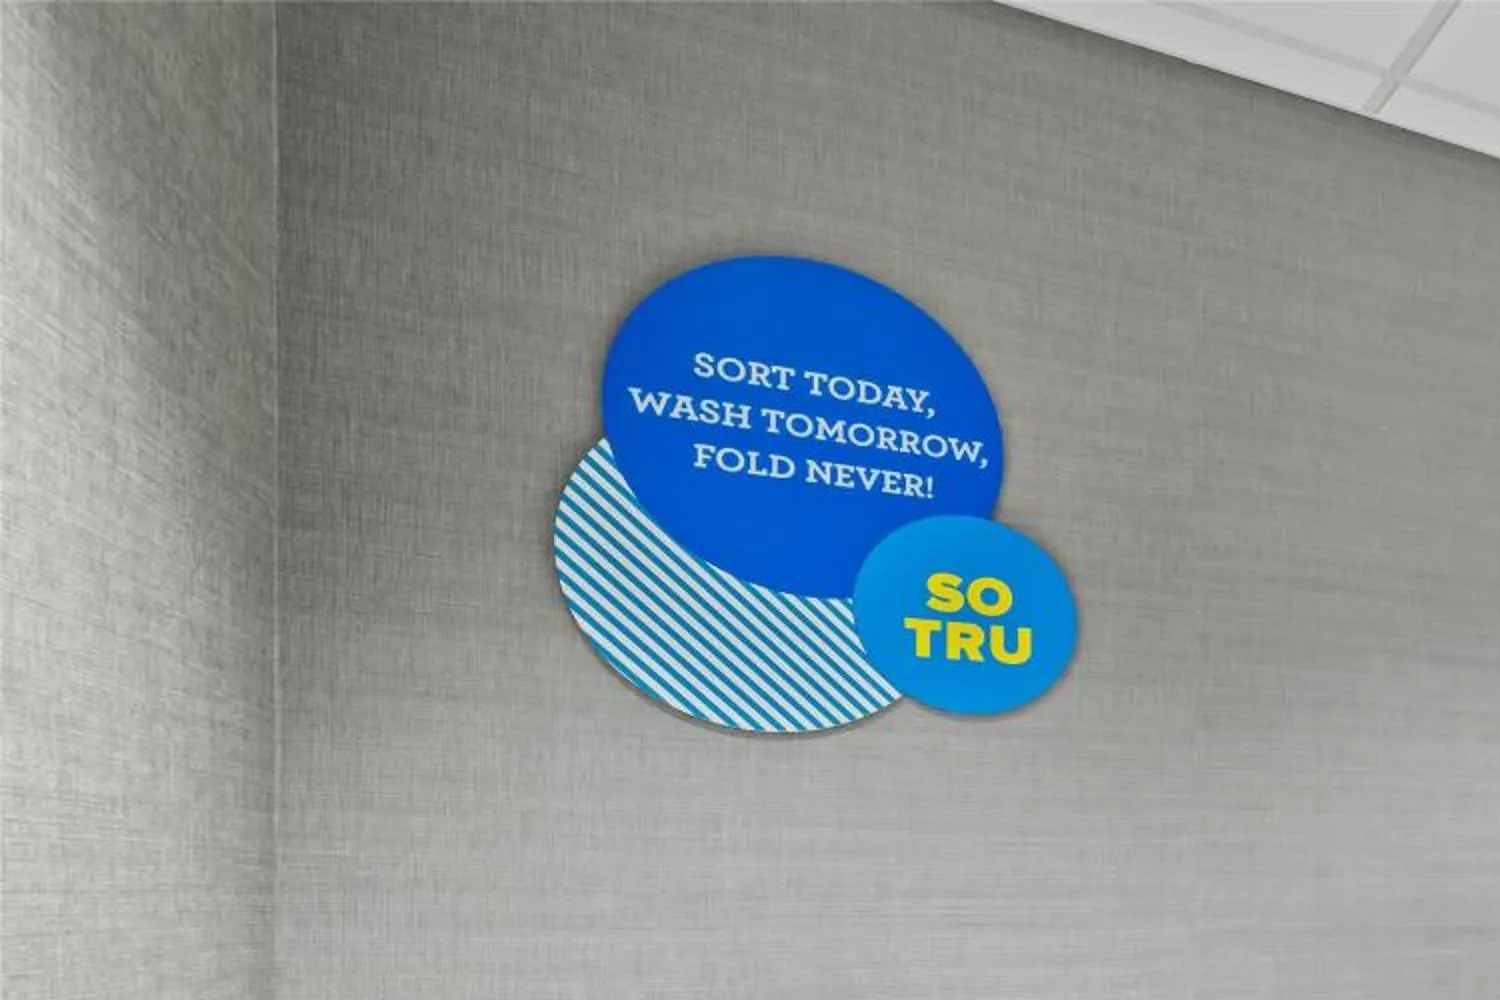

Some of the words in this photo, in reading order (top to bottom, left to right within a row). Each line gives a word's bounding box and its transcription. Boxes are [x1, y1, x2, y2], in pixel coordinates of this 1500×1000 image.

[693, 352, 795, 391] SORT
[804, 370, 935, 419] TODAY,
[628, 387, 752, 431] WASH
[761, 408, 989, 469] TOMORROW,
[693, 443, 795, 480] FOLD
[805, 460, 935, 499] NEVER!
[926, 571, 1013, 617] SO
[904, 617, 1033, 665] TRU
